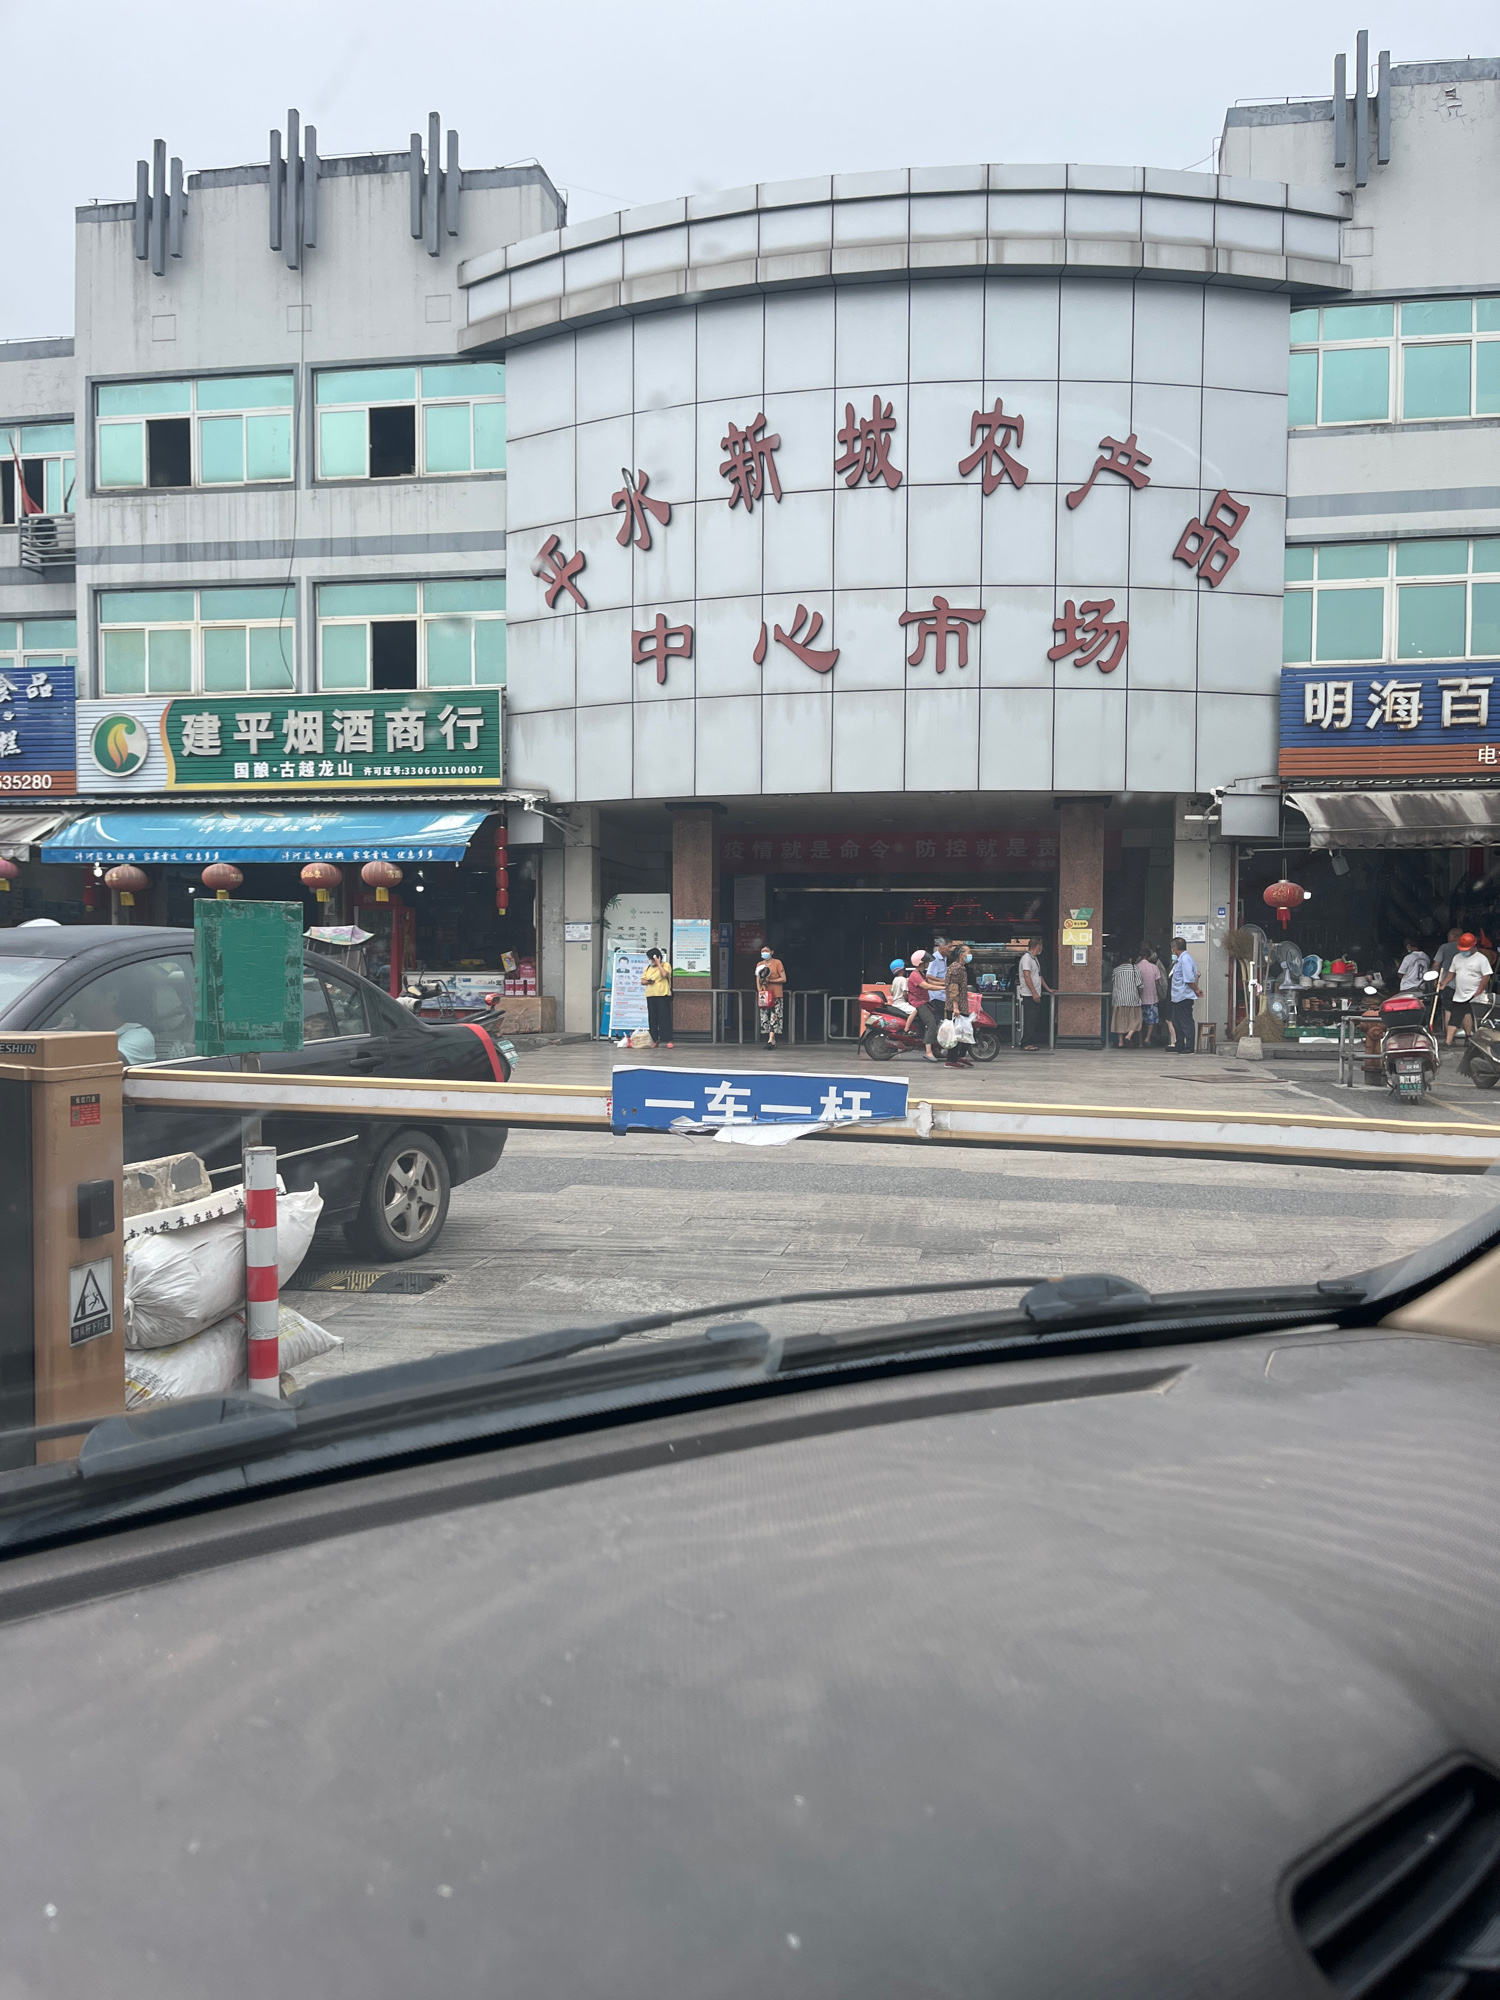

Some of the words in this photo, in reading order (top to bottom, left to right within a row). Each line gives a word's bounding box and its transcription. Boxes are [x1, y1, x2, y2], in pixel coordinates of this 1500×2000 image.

[531, 395, 1250, 609] 平水新城农产品
[631, 596, 1130, 685] 中心市场
[1304, 676, 1494, 730] 明海百
[181, 704, 485, 757] 建平烟酒商行
[1477, 745, 1500, 765] 电
[1066, 931, 1089, 943] 入口
